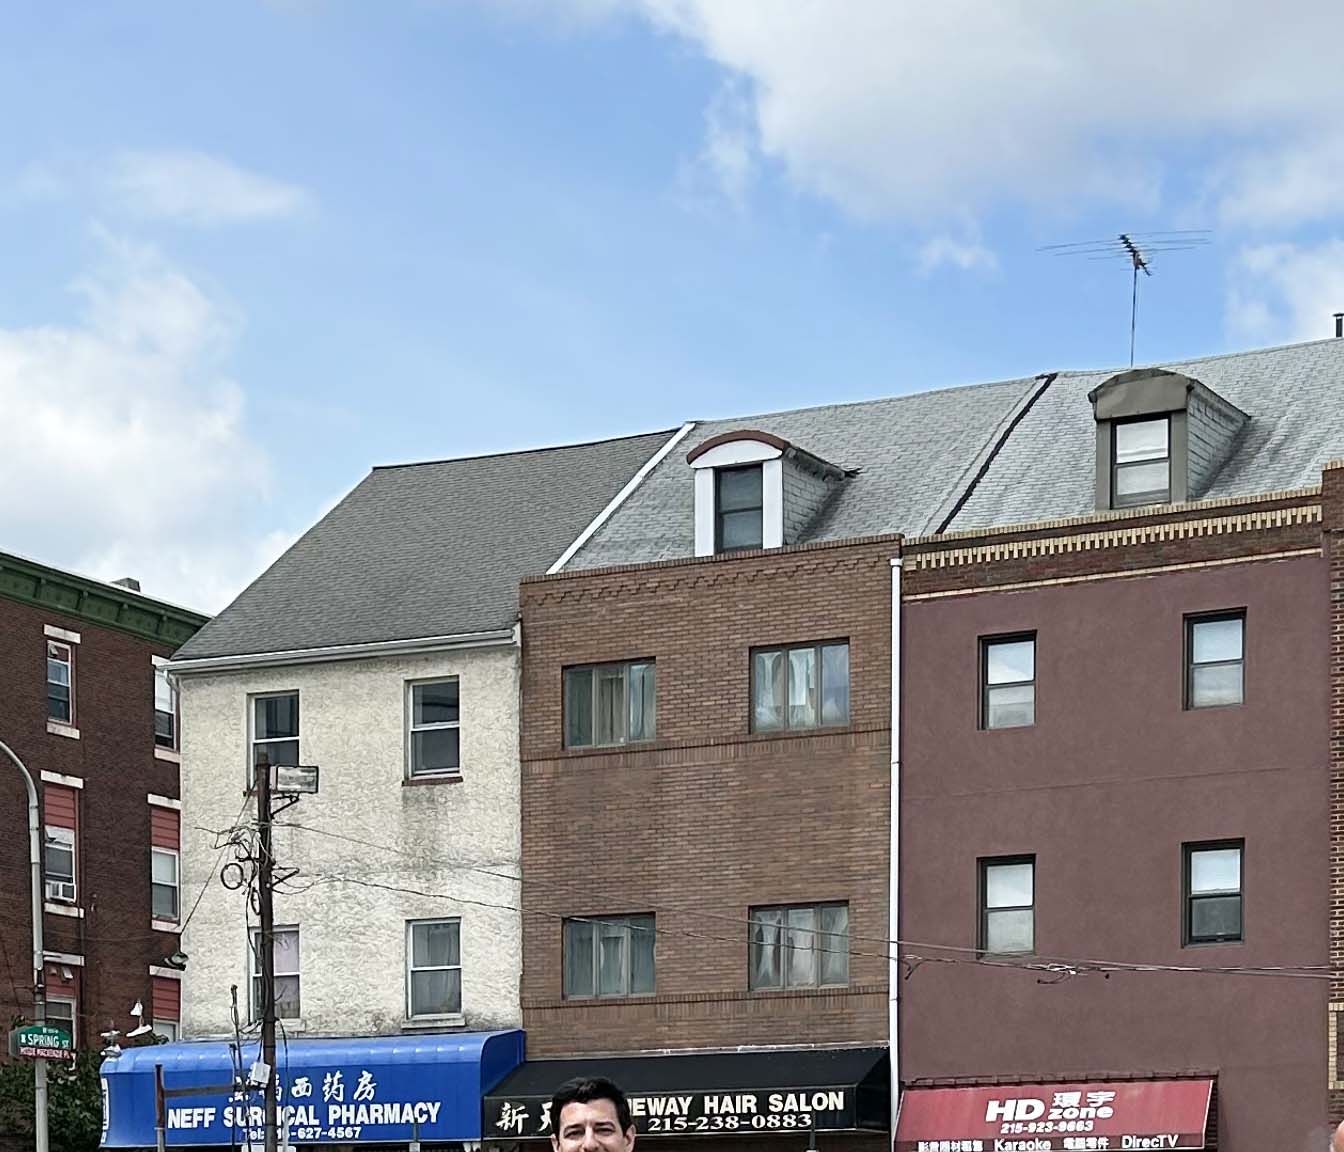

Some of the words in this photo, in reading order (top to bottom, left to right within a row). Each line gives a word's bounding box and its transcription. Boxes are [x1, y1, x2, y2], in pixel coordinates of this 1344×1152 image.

[27, 1033, 60, 1048] SPRING
[627, 1096, 692, 1117] EWAY
[704, 1094, 758, 1114] HAIR
[768, 1091, 844, 1112] SALON
[985, 1099, 1046, 1122] HD
[1047, 1106, 1114, 1120] zone
[168, 1107, 216, 1129] NEFF
[328, 1101, 441, 1125] PHARMACY
[647, 1114, 812, 1132] 215-238-0883
[994, 1138, 1052, 1152] Karaoke
[1121, 1134, 1179, 1149] DirecTV
